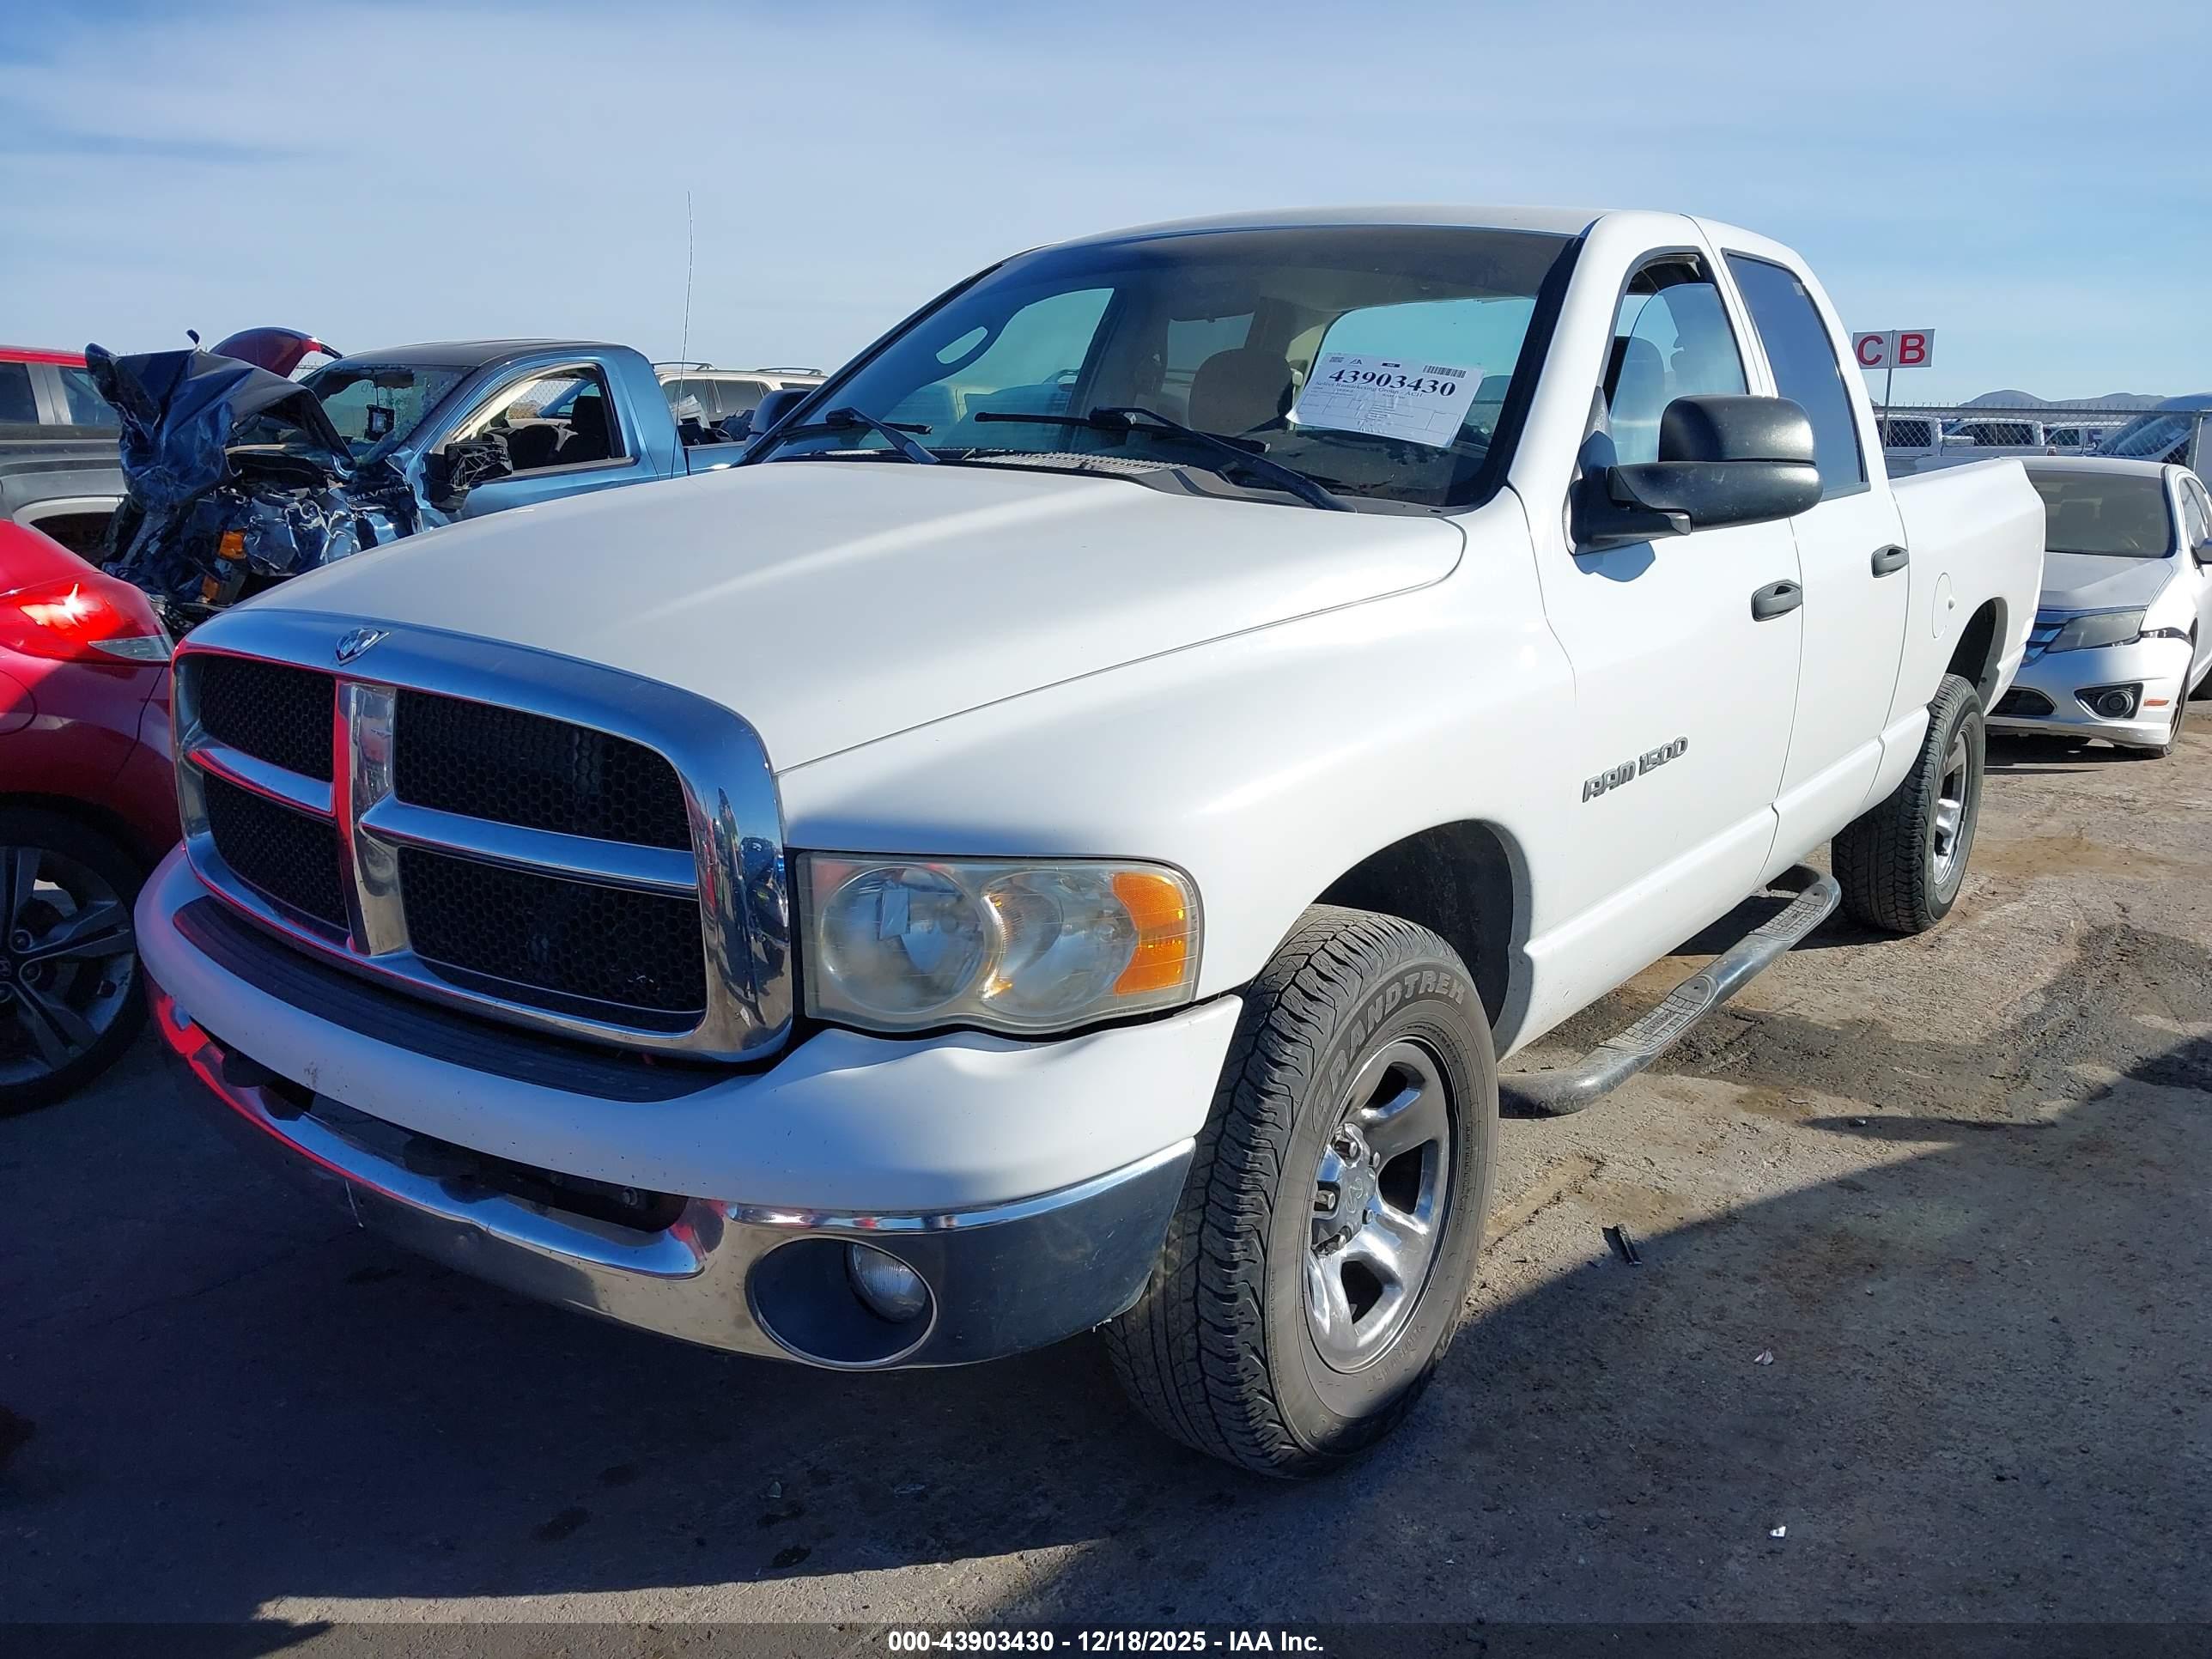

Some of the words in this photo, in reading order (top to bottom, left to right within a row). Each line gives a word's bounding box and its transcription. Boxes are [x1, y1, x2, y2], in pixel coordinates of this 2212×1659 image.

[1857, 335, 1884, 366] C
[1899, 333, 1926, 364] B
[1328, 368, 1456, 397] 43903430
[1582, 759, 1637, 804] RAM
[1638, 735, 1689, 777] 1500
